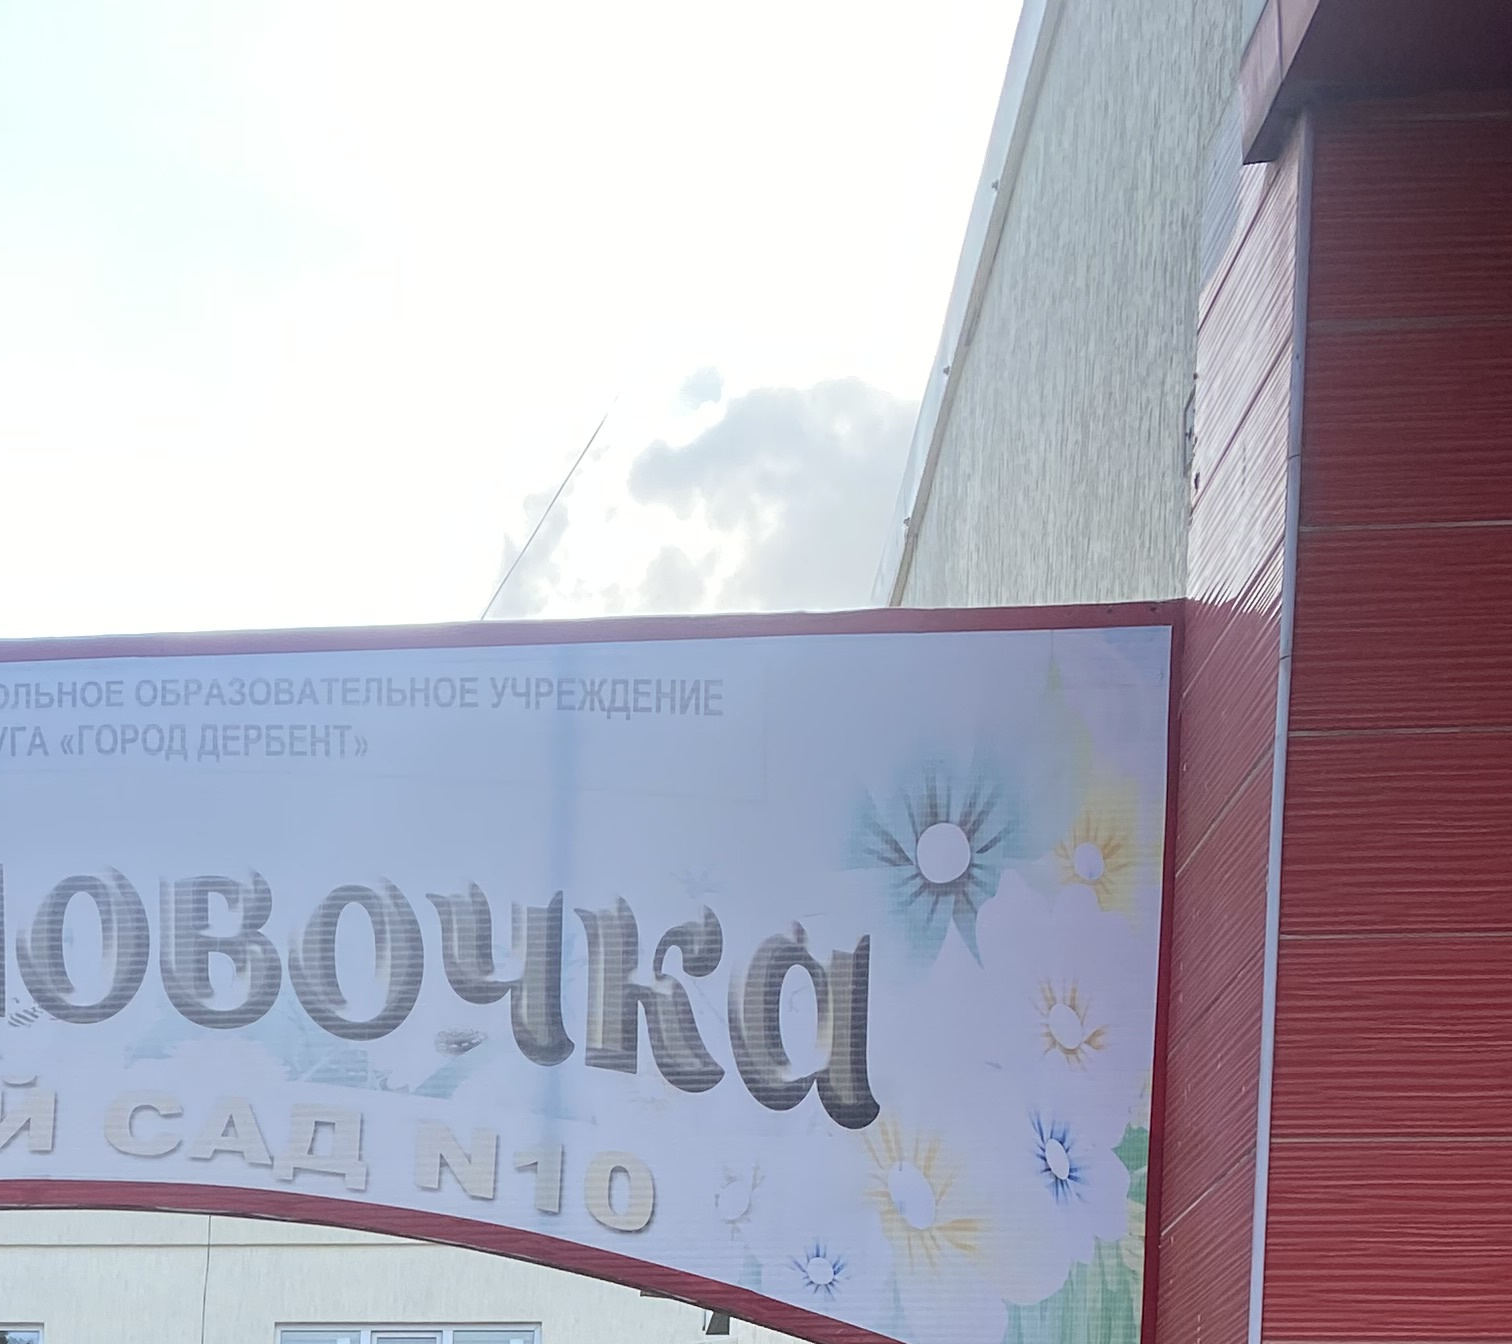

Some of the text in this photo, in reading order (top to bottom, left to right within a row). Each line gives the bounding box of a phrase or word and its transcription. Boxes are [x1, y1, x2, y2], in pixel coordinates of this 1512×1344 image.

[134, 676, 480, 709] ОБРАЗОВАТЕЛЬНОЕ
[489, 676, 725, 721] УЧРЕЖДЕНИЕ
[59, 723, 188, 762] «ГОРОД
[196, 723, 370, 763] ДЕРБЕНТ»
[101, 1088, 369, 1192] САД
[413, 1118, 657, 1234] N10
